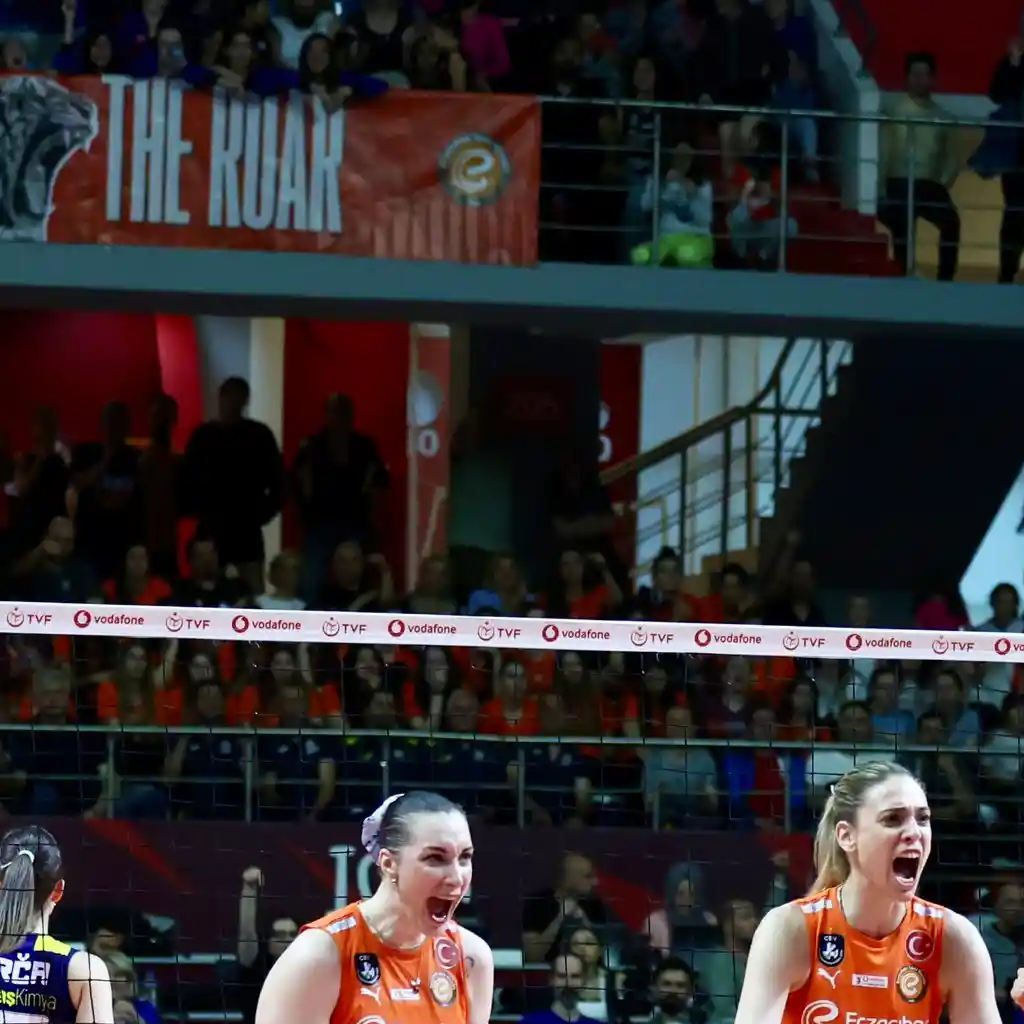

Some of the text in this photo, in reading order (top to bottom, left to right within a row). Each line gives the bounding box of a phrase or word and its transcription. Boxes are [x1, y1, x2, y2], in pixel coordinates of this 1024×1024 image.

[101, 73, 193, 225] THE
[208, 84, 345, 233] ROAR
[26, 613, 53, 626] TVF
[93, 613, 145, 626] vodafone
[184, 618, 211, 630] TVF
[251, 619, 302, 631] vodafone
[341, 623, 368, 635] TVF
[407, 623, 458, 635] vodafone
[496, 627, 523, 639] TVF
[561, 628, 611, 640] vodafone
[649, 632, 675, 644] TVF
[713, 632, 762, 645] vodafone
[800, 637, 826, 648] TVF
[864, 637, 913, 649] vodafone
[950, 641, 976, 653] TVF
